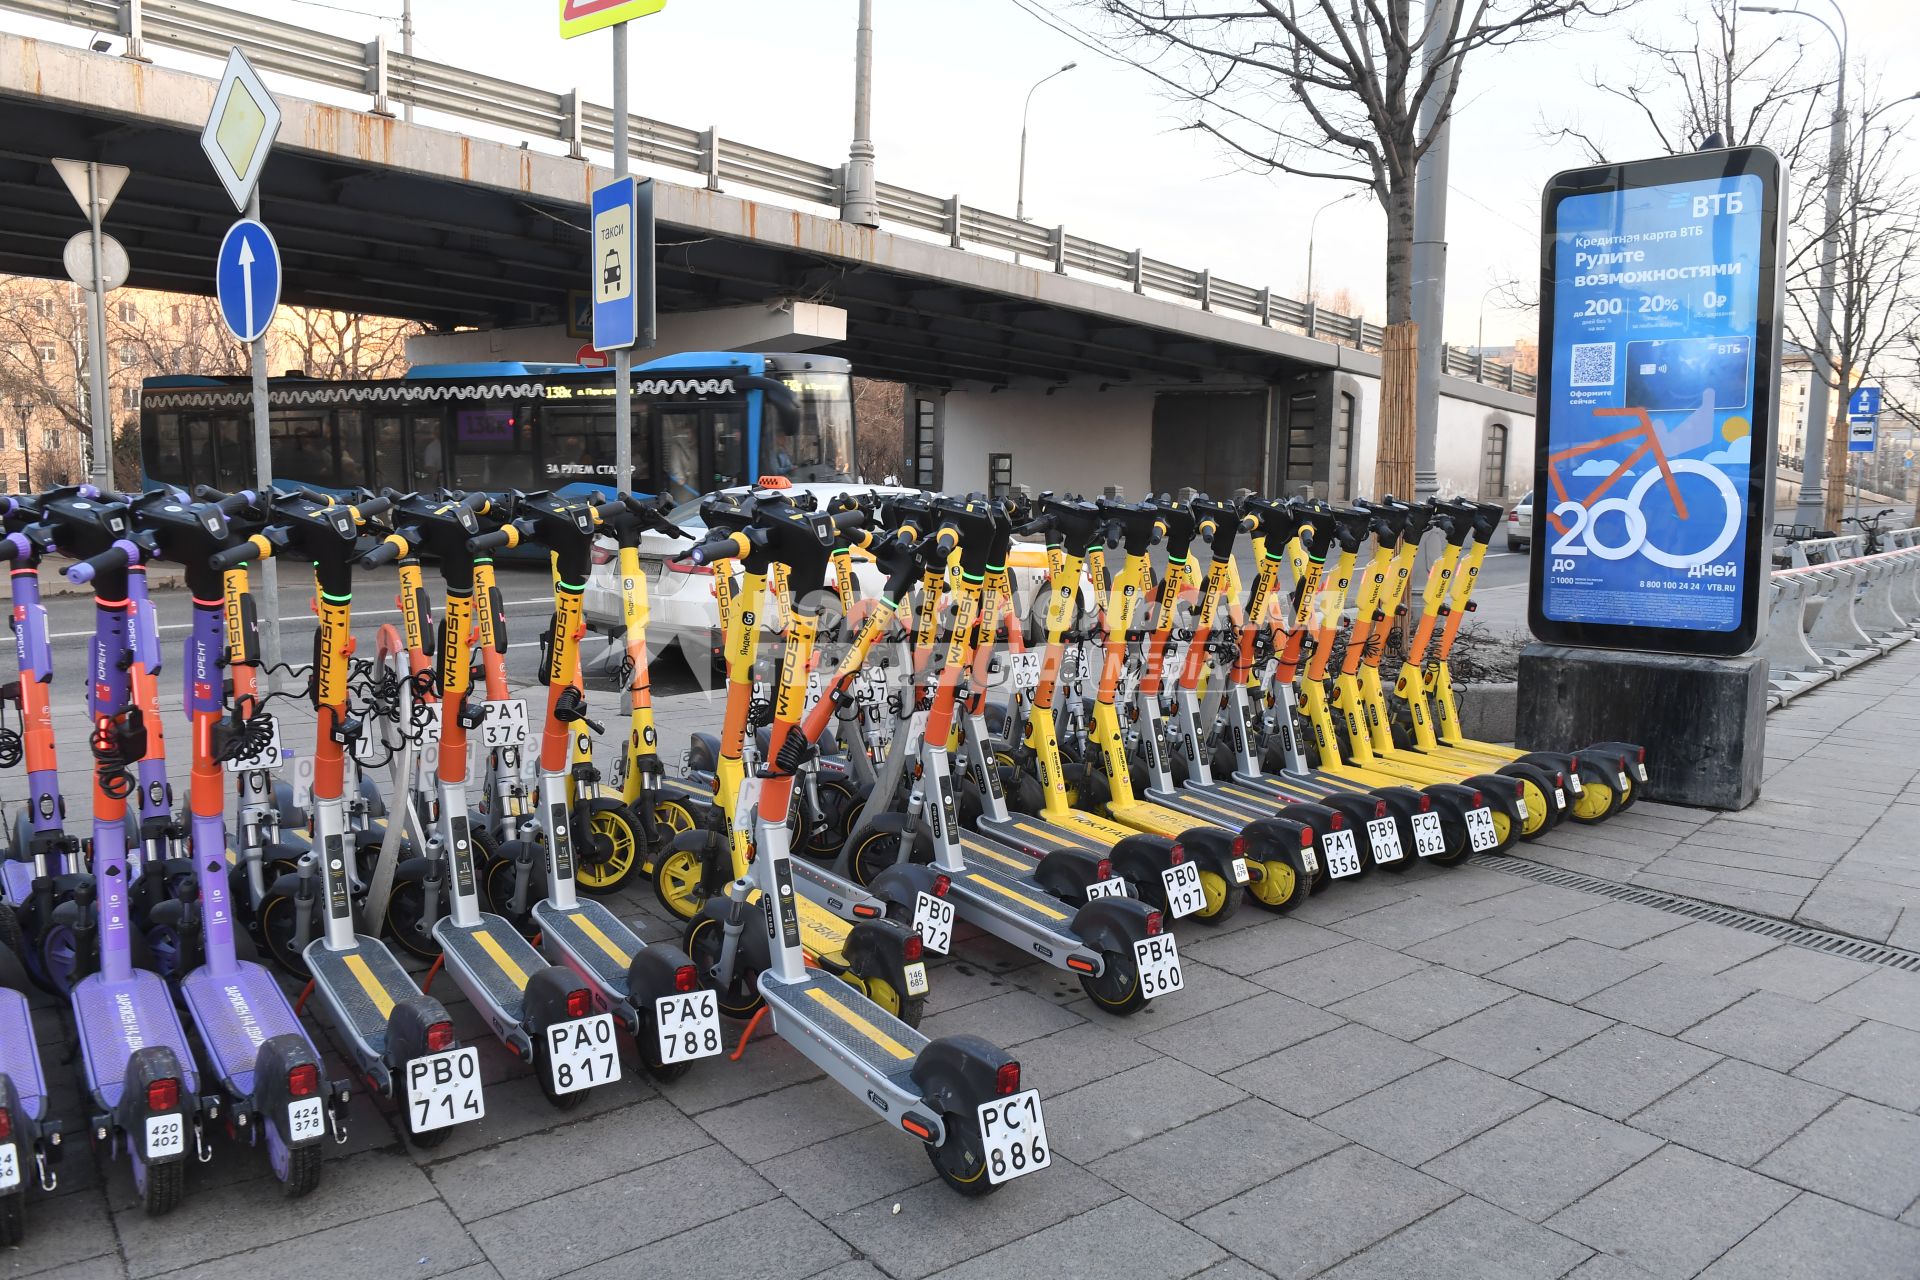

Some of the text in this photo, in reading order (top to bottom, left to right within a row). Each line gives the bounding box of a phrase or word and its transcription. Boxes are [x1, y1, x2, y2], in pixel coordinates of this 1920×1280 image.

[1692, 191, 1744, 218] ВТБ
[601, 224, 624, 240] такси
[1575, 226, 1703, 248] Кредитная карта ВТБ
[1575, 250, 1645, 270] Рулите
[1574, 262, 1741, 287] возможностями
[1573, 298, 1622, 319] до 200
[1639, 295, 1679, 313] 20%
[1718, 343, 1741, 355] ВТБ
[1570, 389, 1611, 400] Оформите
[1570, 397, 1596, 405] сейчас
[546, 464, 559, 474] ЗА
[561, 464, 594, 475] РУЛЕМ
[1551, 459, 1741, 568] 200
[1552, 559, 1575, 573] до
[1688, 562, 1736, 578] дней
[1094, 555, 1108, 611] WHOOSH
[1200, 566, 1222, 624] WHOOSH
[1251, 564, 1273, 621] WHOOSH
[1299, 566, 1319, 622] WHOOSH
[1370, 573, 1384, 604] Яндекс Go
[1436, 569, 1451, 598] Яндекс Go
[1556, 577, 1574, 585] 1000
[1647, 581, 1661, 589] 800
[1663, 581, 1677, 589] 100
[1679, 582, 1689, 590] 24
[1707, 583, 1736, 592] VTB.RU
[401, 571, 419, 648] WHOOSH
[475, 571, 491, 646] WHOOSH
[918, 577, 938, 646] WHOOSH
[980, 577, 998, 643] WHOOSH
[1057, 586, 1071, 624] Яндекс Go
[1121, 584, 1135, 621] Яндекс Go
[1159, 569, 1179, 629] WHOOSH
[226, 574, 242, 658] WHOOSH
[948, 588, 974, 664] WHOOSH
[16, 624, 25, 658] ЮРЕНТ
[128, 618, 137, 652] ЮРЕНТ
[445, 601, 459, 688] WHOOSH
[551, 597, 568, 679] WHOOSH
[740, 611, 755, 656] Яндекс Go
[841, 608, 881, 669] WHOOSH
[320, 609, 333, 698] WHOOSH
[777, 619, 801, 716] WHOOSH
[1013, 655, 1038, 668] PA2
[1017, 671, 1040, 685] 821
[484, 703, 524, 720] PA1
[486, 725, 526, 743] 376
[1369, 819, 1394, 840] PB9
[1413, 818, 1438, 833] PC2
[1467, 813, 1491, 829] PA2
[1325, 835, 1352, 854] PA1
[1374, 840, 1401, 862] 001
[1418, 835, 1443, 854] 862
[1473, 831, 1496, 849] 658
[1330, 856, 1358, 874] 356
[1165, 868, 1196, 891] PB0
[918, 895, 952, 924] PB0
[1173, 890, 1204, 913] 197
[1137, 937, 1175, 966] PB4
[909, 970, 923, 979] 146
[910, 978, 924, 987] 685
[1144, 966, 1181, 993] 560
[115, 993, 137, 1025] ЗАРЯЖЕН
[224, 985, 249, 1017] ЗАРЯЖЕН
[660, 995, 714, 1026] PA6
[552, 1019, 611, 1054] PA0
[664, 1028, 718, 1060] 788
[412, 1053, 474, 1090] PB0
[557, 1054, 614, 1088] 817
[294, 1106, 318, 1119] 424
[415, 1090, 480, 1126] 714
[982, 1096, 1038, 1137] PC1
[152, 1123, 178, 1136] 420
[296, 1118, 319, 1131] 378
[152, 1135, 178, 1147] 402
[991, 1136, 1045, 1177] 886
